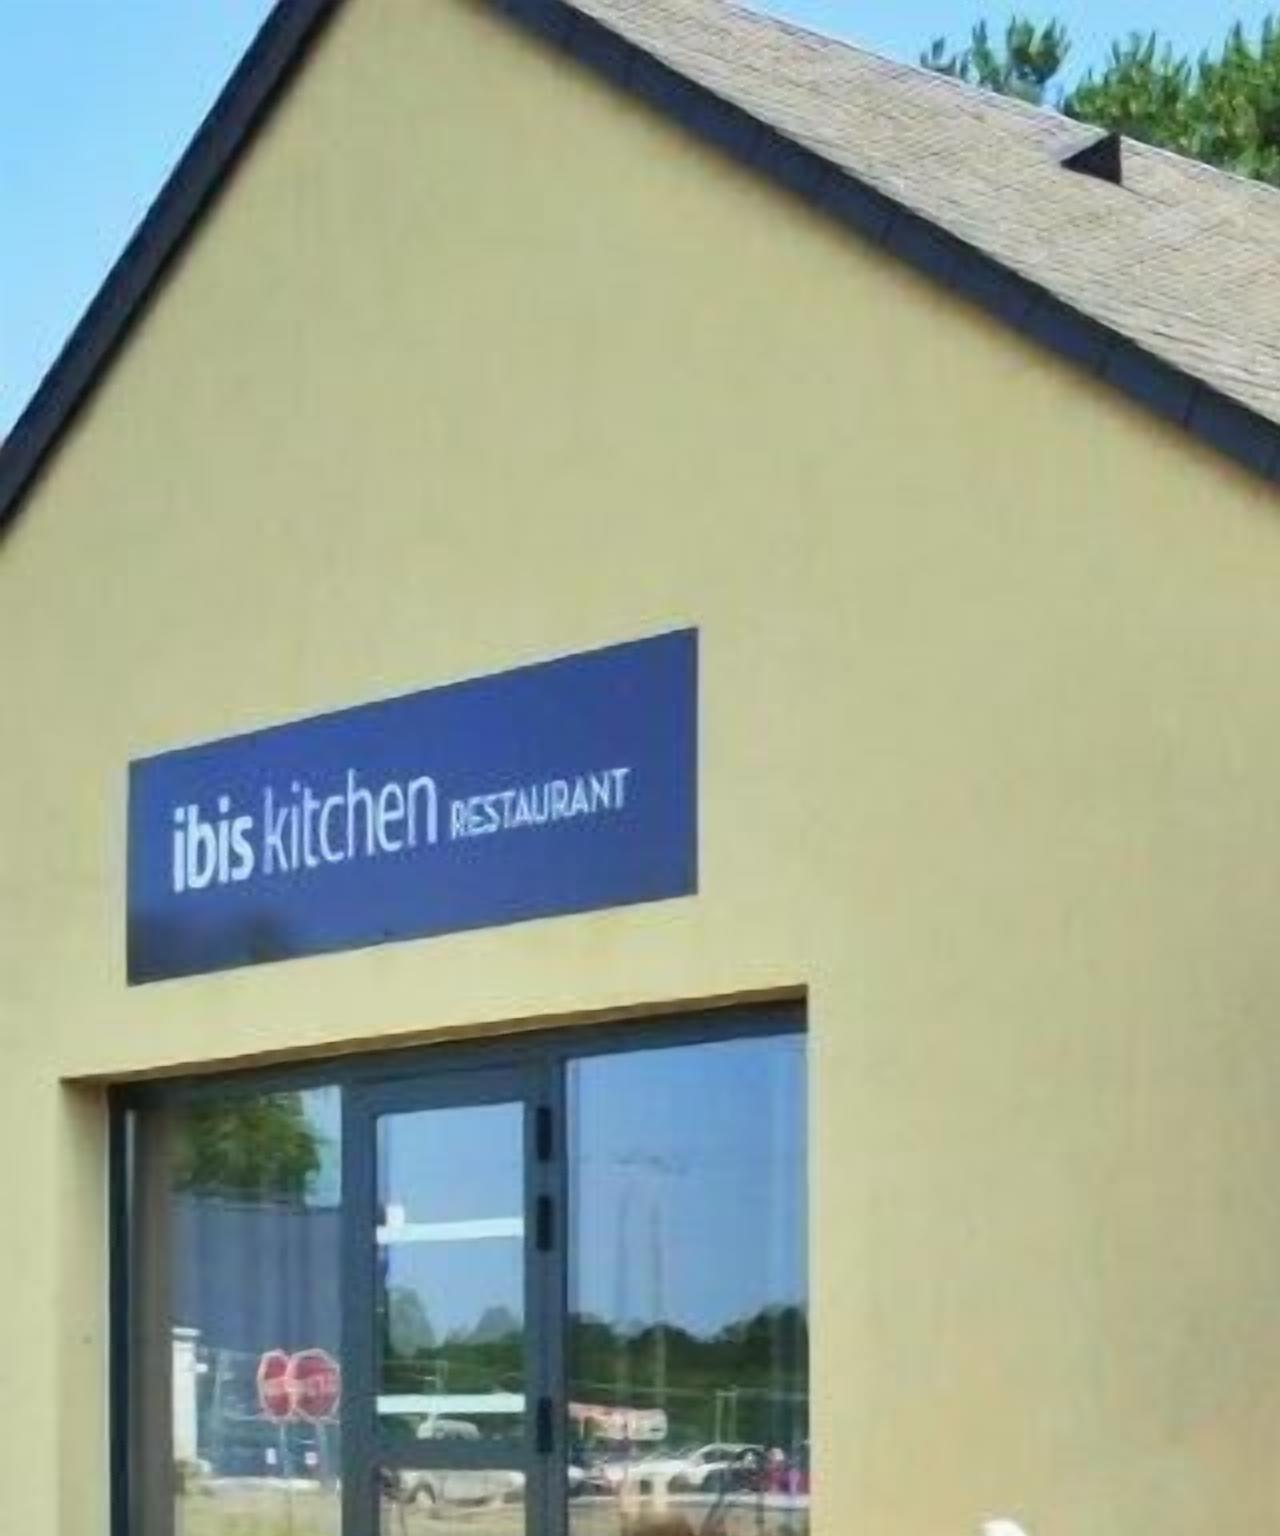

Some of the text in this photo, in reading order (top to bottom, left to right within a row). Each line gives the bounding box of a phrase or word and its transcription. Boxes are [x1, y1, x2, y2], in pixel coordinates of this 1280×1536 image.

[172, 768, 630, 893] ibis kitchen RESTAURANT
